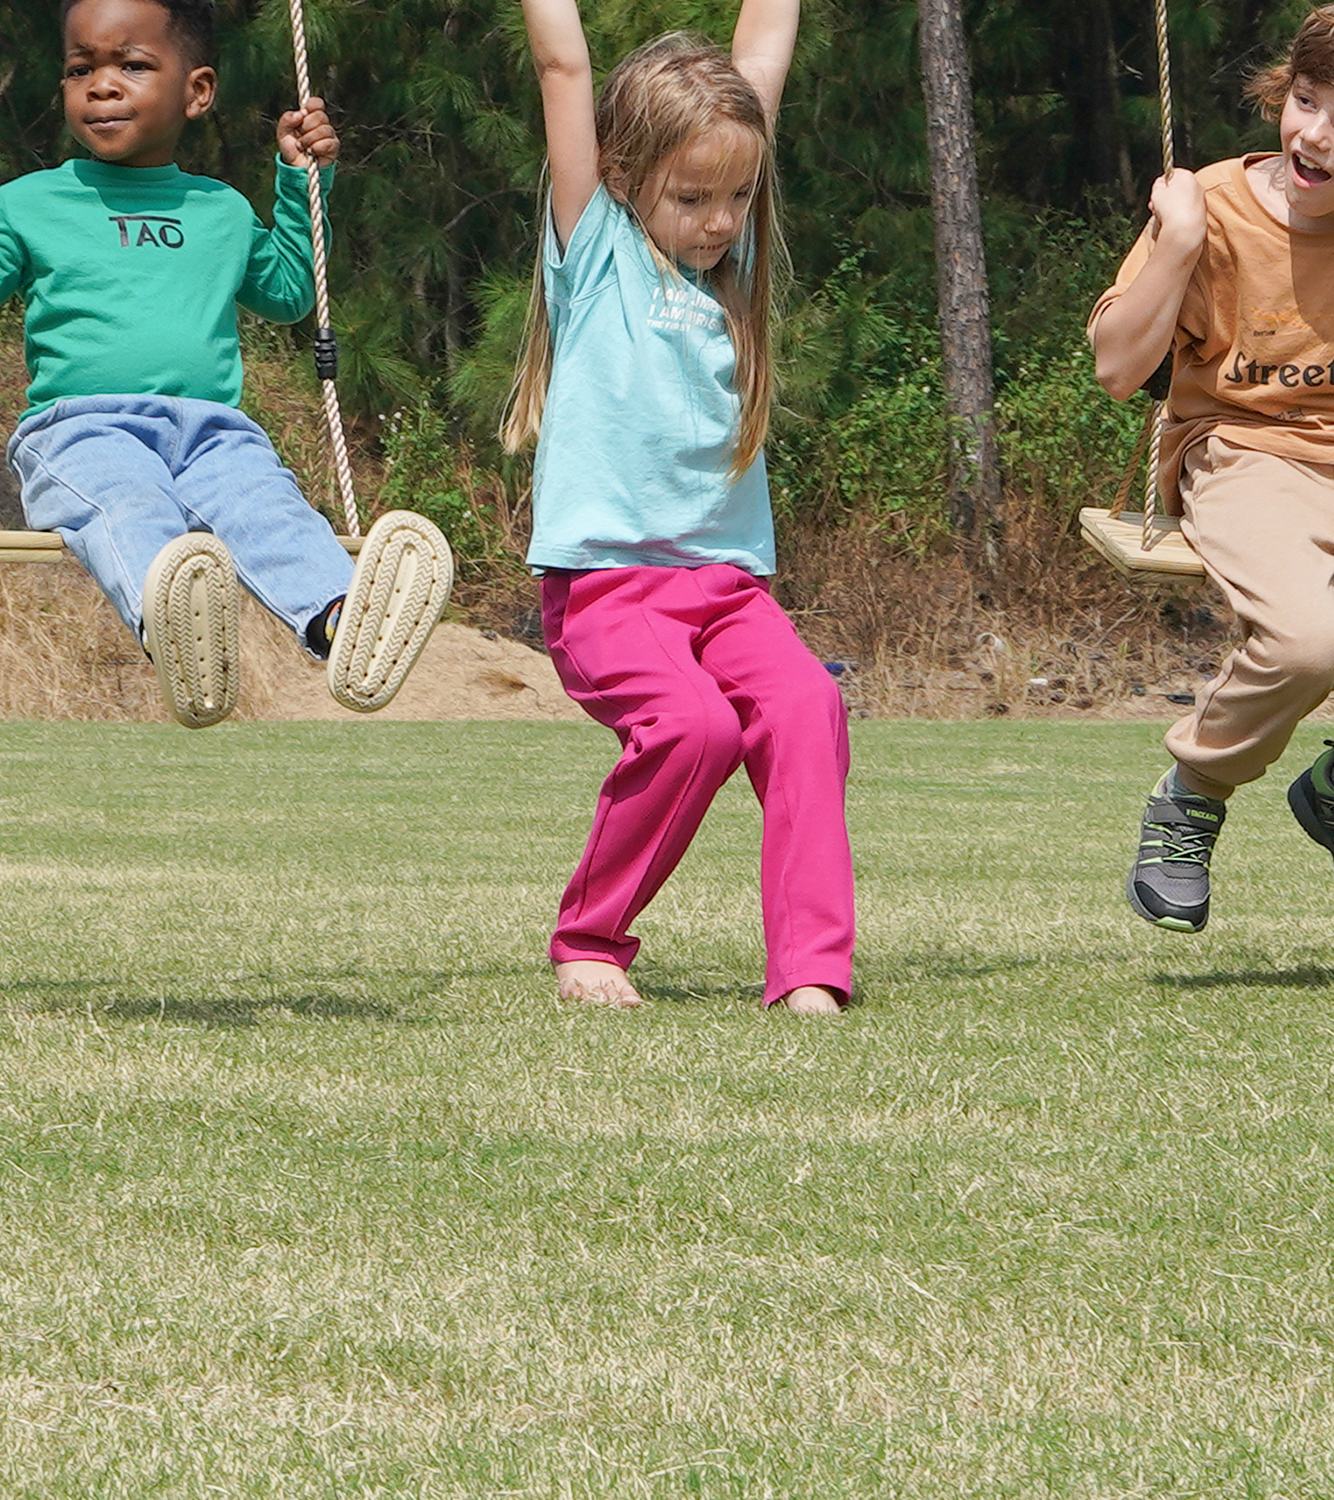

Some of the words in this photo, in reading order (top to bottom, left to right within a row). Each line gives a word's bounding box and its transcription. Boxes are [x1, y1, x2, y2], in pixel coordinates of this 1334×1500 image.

[109, 216, 184, 248] TAO
[652, 287, 660, 300] I
[662, 288, 689, 303] AM
[648, 304, 656, 316] I
[659, 306, 686, 320] AM
